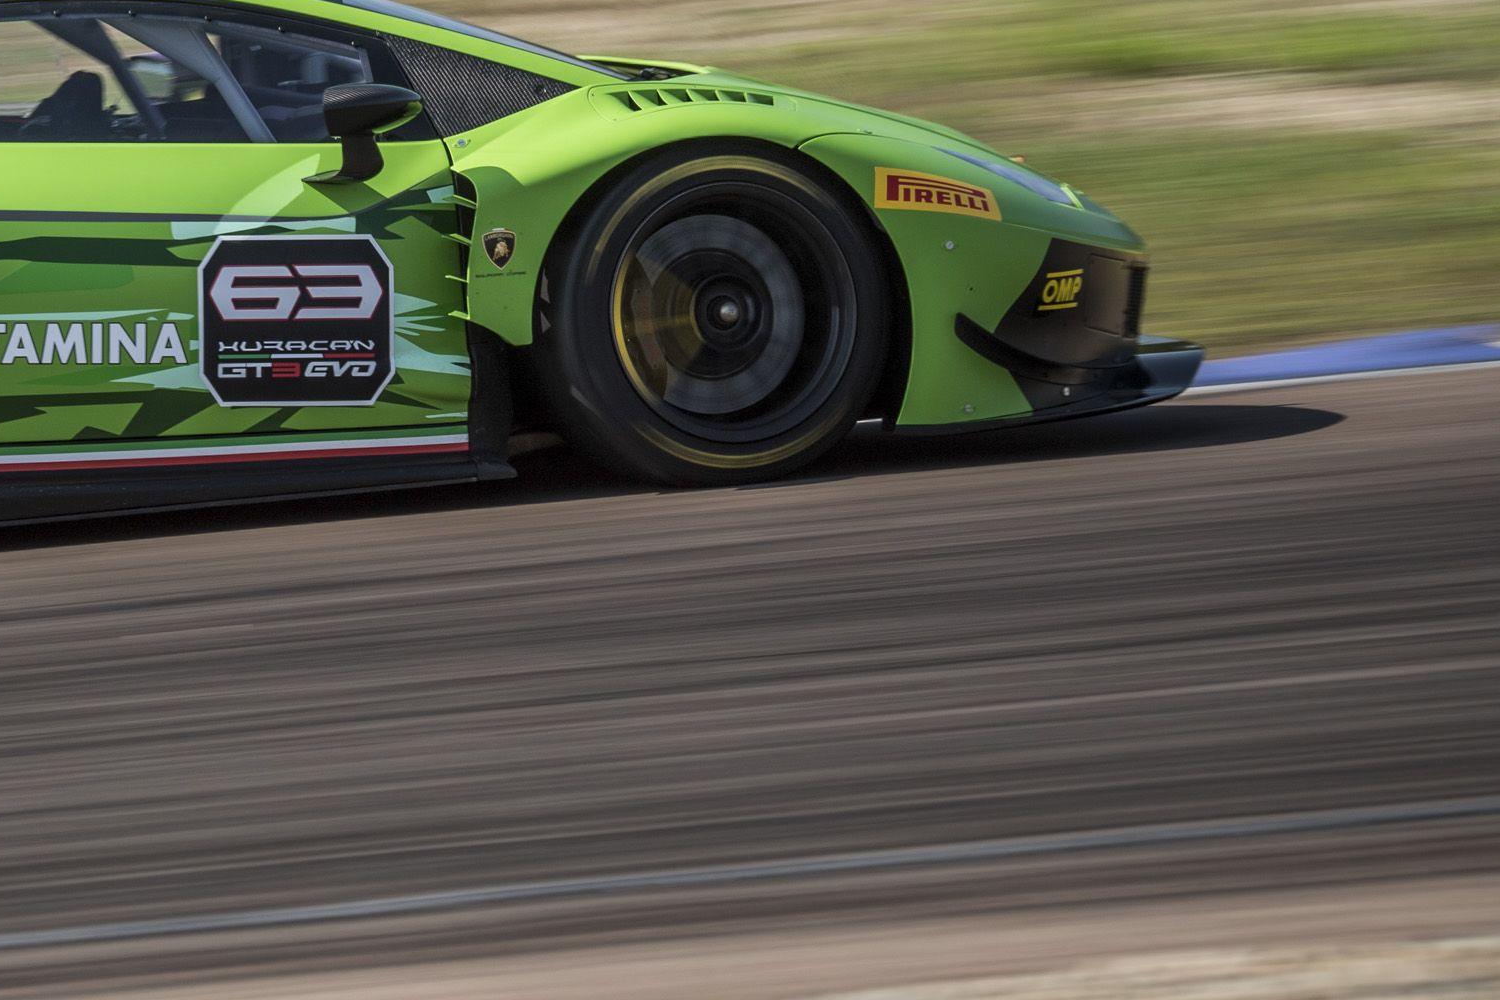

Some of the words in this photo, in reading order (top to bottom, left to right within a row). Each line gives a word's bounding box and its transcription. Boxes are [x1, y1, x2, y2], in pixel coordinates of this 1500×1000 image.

[886, 174, 990, 213] PIRELLI
[210, 264, 383, 321] 63
[1041, 275, 1083, 304] OMP
[217, 362, 301, 379] GT3
[304, 361, 377, 378] EVO
